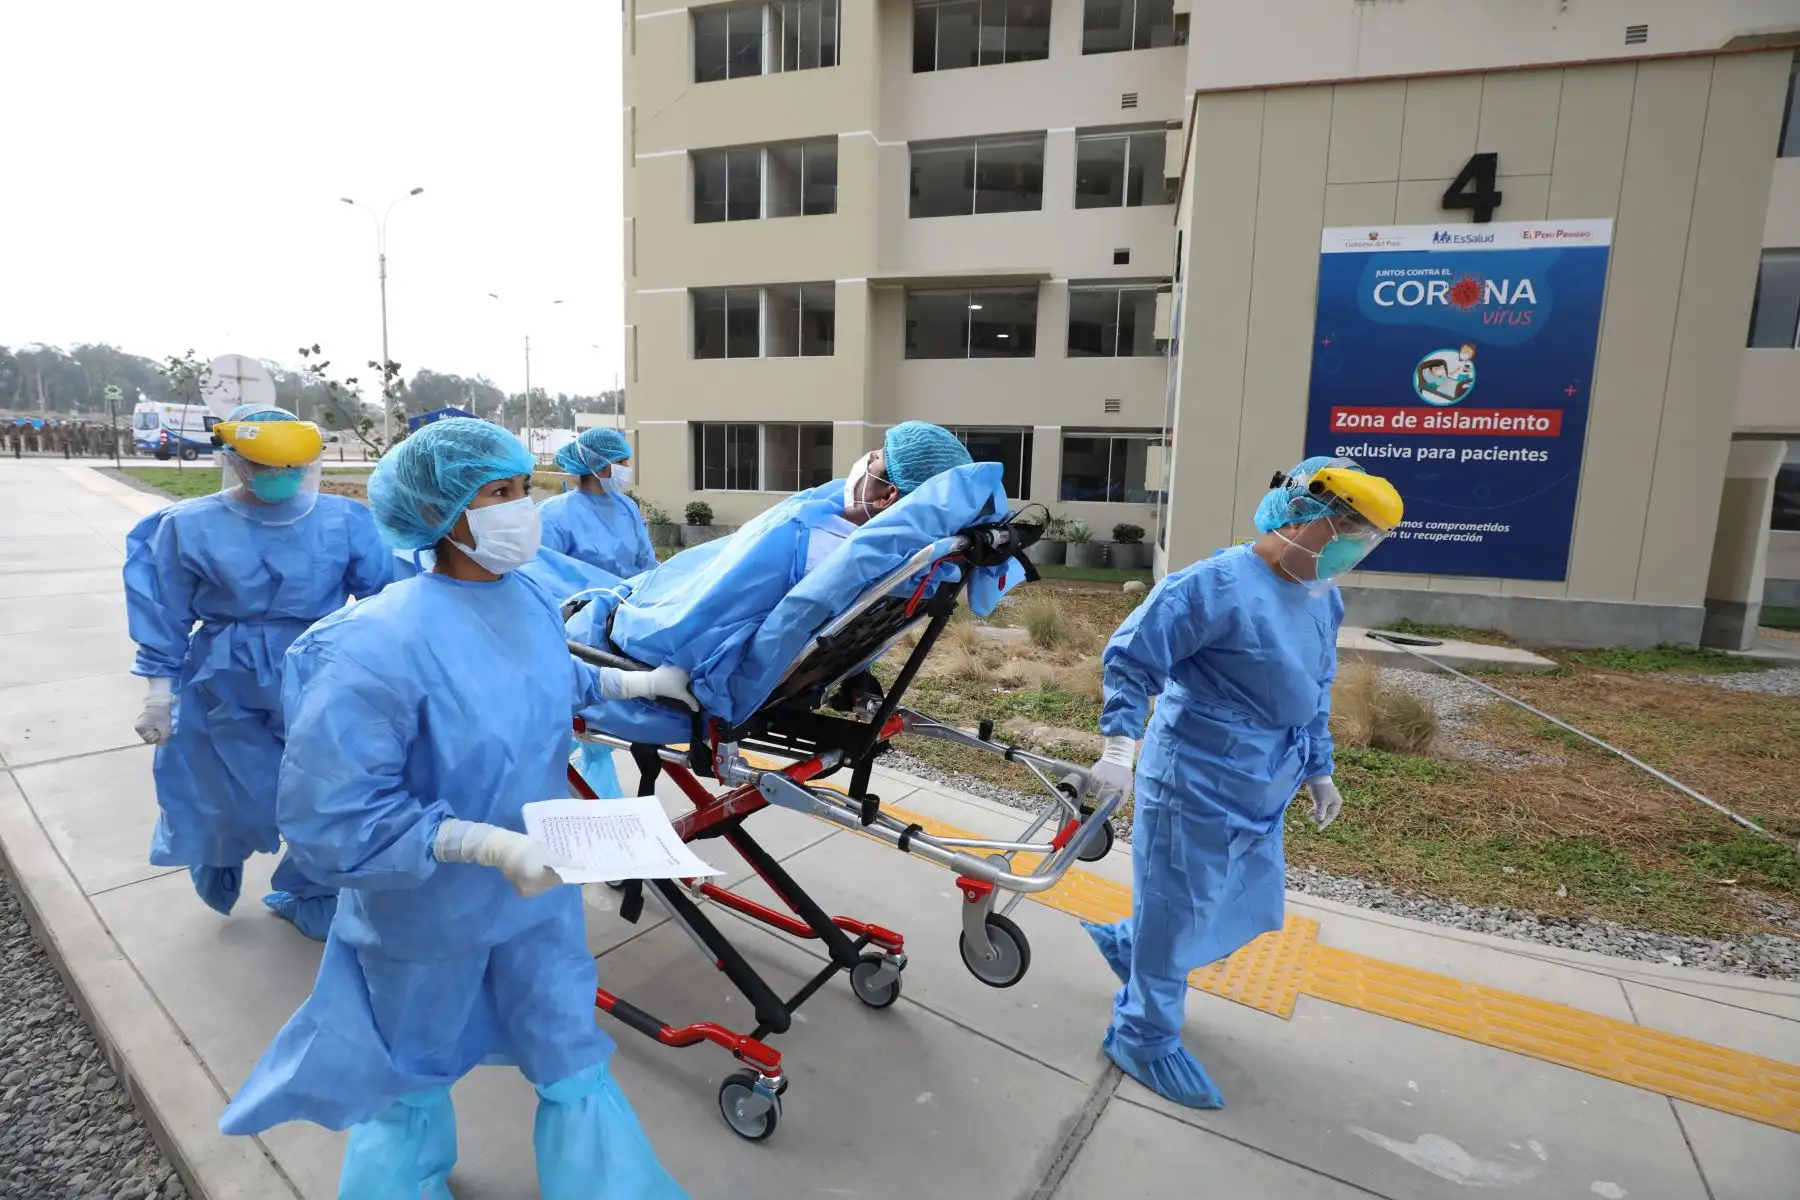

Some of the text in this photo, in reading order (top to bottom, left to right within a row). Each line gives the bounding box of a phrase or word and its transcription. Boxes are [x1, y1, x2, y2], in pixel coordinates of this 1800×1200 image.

[1442, 152, 1502, 223] 4
[1453, 232, 1495, 244] EsSalud
[1375, 269, 1405, 277] JUNTOS
[1483, 306, 1533, 325] virus
[1335, 410, 1550, 431] Zona de aislamiento
[1335, 443, 1549, 462] exclusiva para pacientes
[1425, 521, 1511, 533] comprometidos
[1400, 531, 1411, 539] tu
[1413, 532, 1483, 542] recuperación
